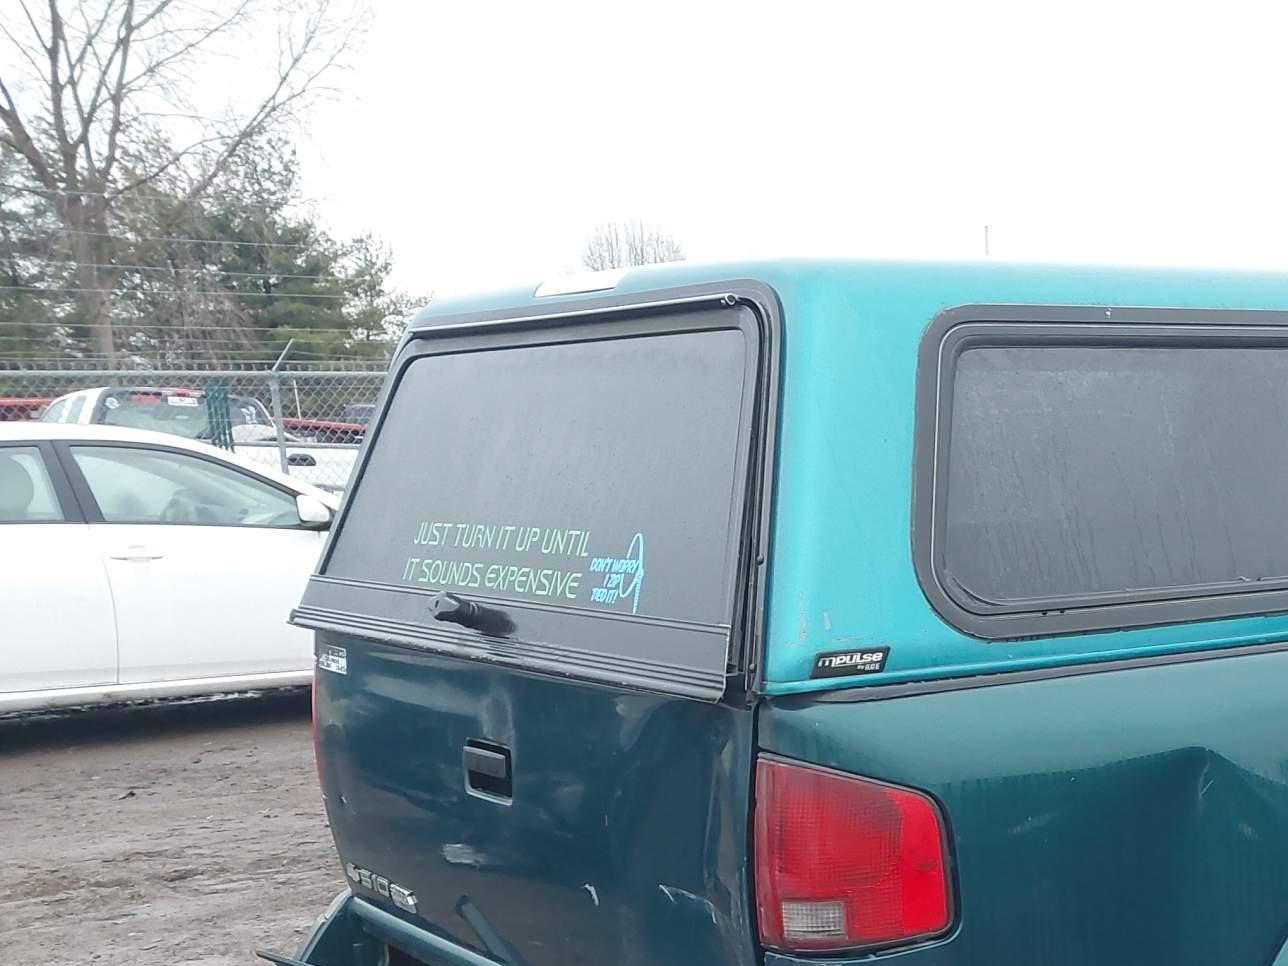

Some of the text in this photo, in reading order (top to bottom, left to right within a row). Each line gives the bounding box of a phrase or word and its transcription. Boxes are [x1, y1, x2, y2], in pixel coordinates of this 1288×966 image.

[413, 521, 590, 557] JUST TURN IT UP UNTIL
[402, 557, 582, 599] IT SOUNDS EXPENSIVE
[590, 557, 640, 574] DON'T WORRY
